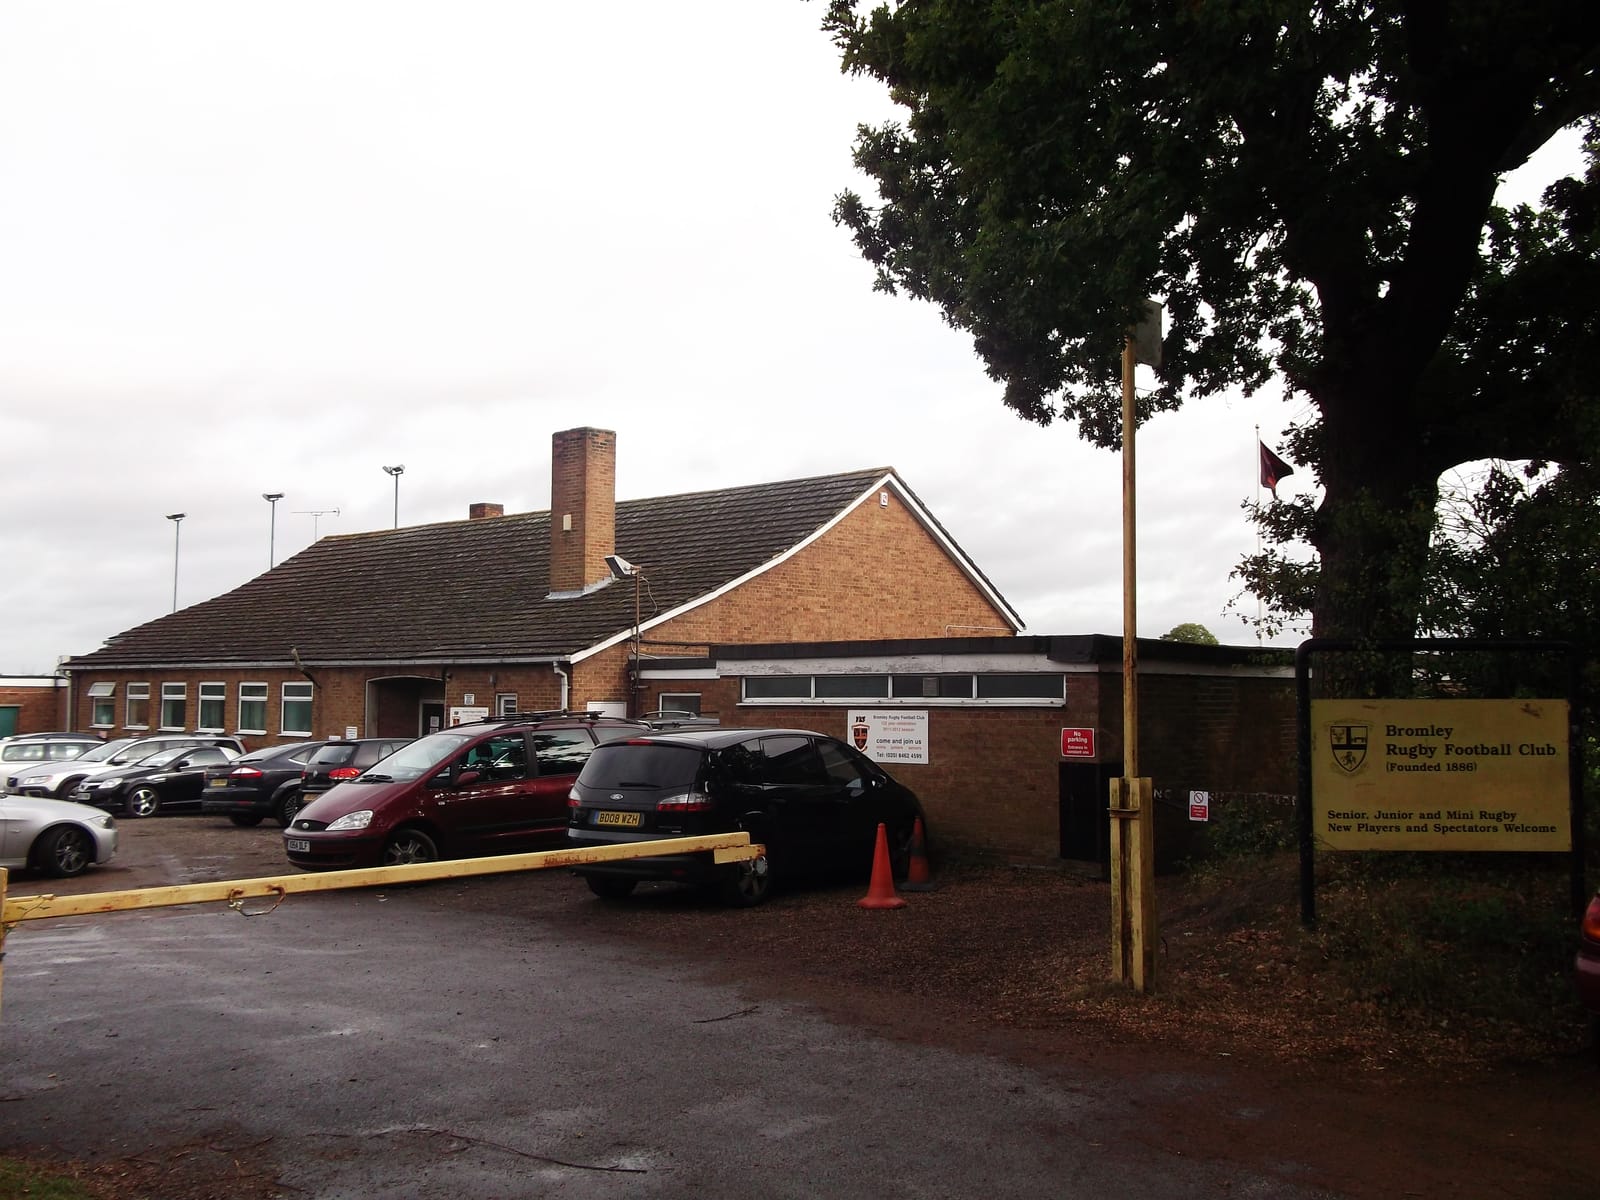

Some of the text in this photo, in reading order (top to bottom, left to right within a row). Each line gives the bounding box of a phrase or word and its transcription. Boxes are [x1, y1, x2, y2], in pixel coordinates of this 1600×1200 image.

[1385, 724, 1454, 739] Bromley
[1067, 736, 1088, 744] parking
[1385, 743, 1557, 759] Rugby Football Club
[1385, 762, 1478, 773] (Founded 1886)
[621, 814, 638, 825] WZH
[1373, 810, 1415, 821] Junior
[1418, 810, 1442, 820] and
[1446, 810, 1474, 820] Mini
[1478, 810, 1517, 822] Rugby
[1327, 823, 1557, 835] New Players and Spectators Welcome
